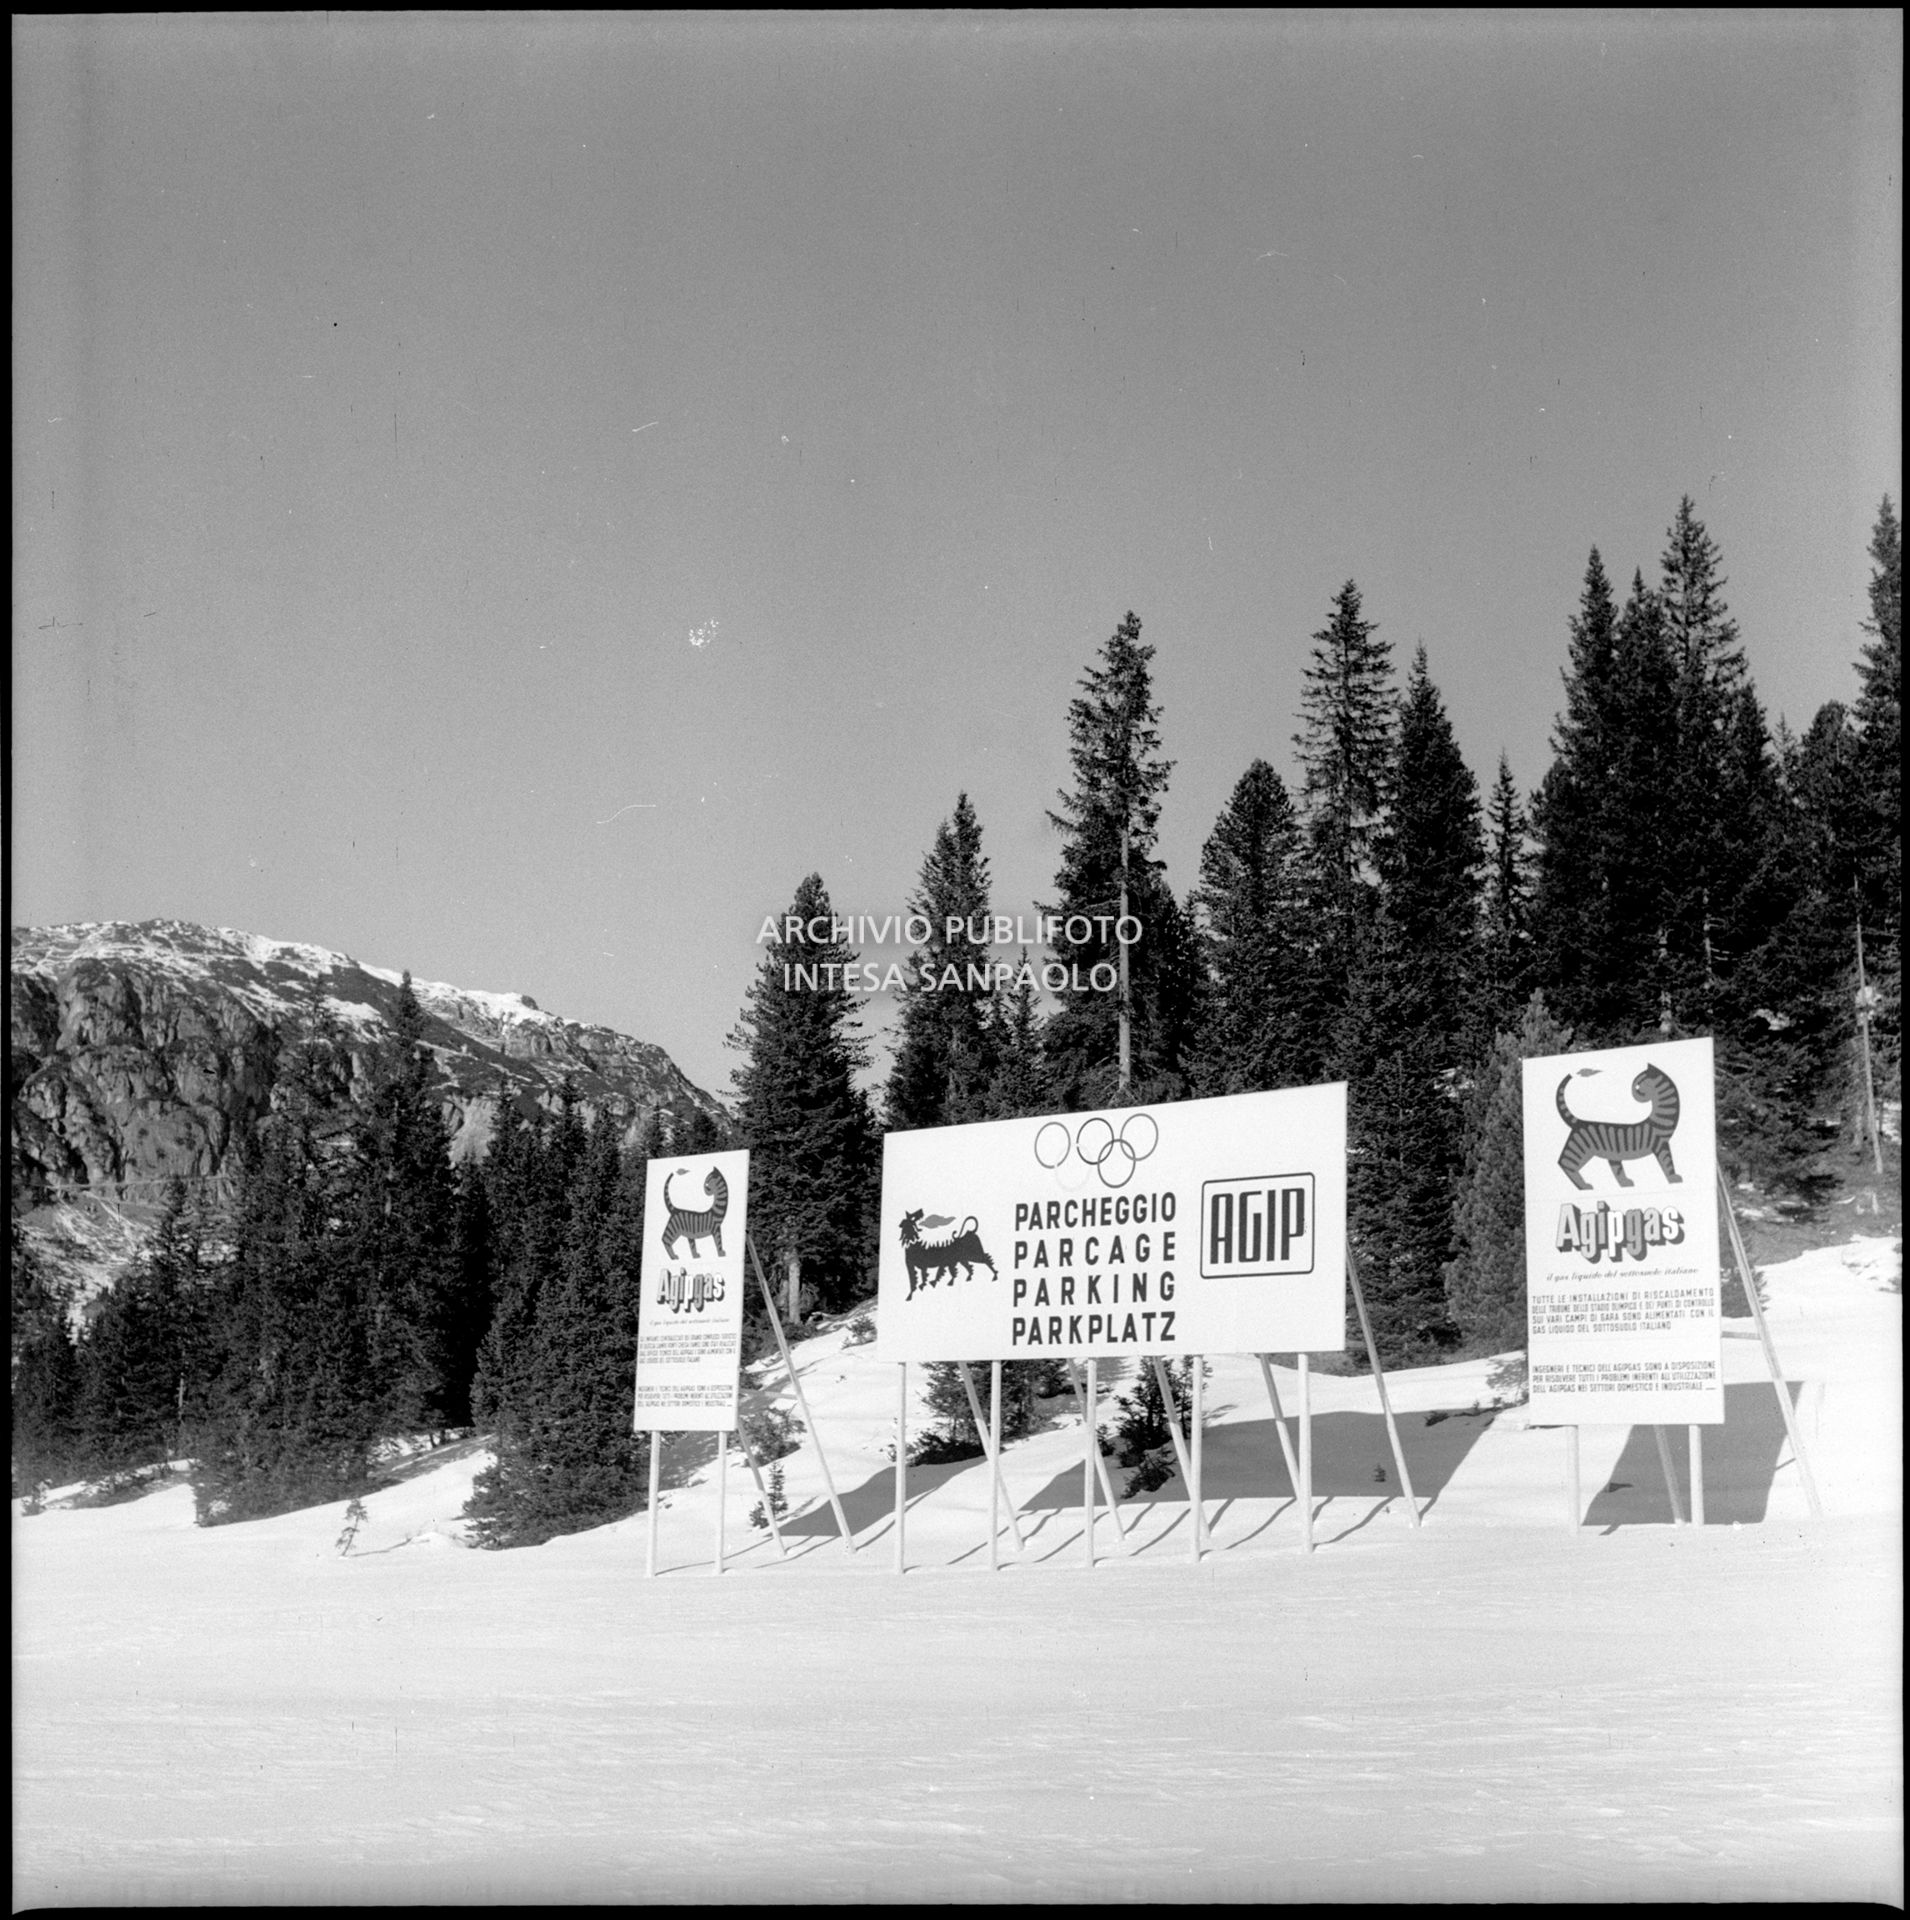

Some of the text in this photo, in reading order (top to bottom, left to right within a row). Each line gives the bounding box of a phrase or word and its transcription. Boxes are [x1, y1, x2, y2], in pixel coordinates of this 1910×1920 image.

[1015, 1192, 1176, 1231] PARCHEGGIO
[1210, 1187, 1305, 1265] AGIP
[1555, 1201, 1685, 1264] Agipgas
[1014, 1232, 1176, 1269] PARCAGE
[657, 1267, 725, 1314] Agipgas
[1013, 1271, 1175, 1308] PARKING
[1532, 1288, 1714, 1304] TUTTE LE INSTALLAZIONI DI RISCALDAMENTO
[1533, 1309, 1714, 1324] SUI VARI CAMPI DI GARA SONO ALIMENTATI CON IL
[1675, 1300, 1682, 1308] DI
[1012, 1311, 1176, 1346] PARKPLATZ
[1533, 1321, 1671, 1334] GAS LIQUIDO DEL SOTTOSUOLO ITALIANO
[1533, 1375, 1542, 1383] PER
[1601, 1373, 1629, 1381] PROBLEMI
[1572, 1364, 1595, 1372] TECNICI
[1645, 1362, 1662, 1370] SONO
[1665, 1362, 1668, 1370] A
[1671, 1361, 1715, 1370] DISPOSIZIONE
[1618, 1383, 1653, 1391] DOMESTICO
[1662, 1382, 1702, 1390] INDUSTRIALE
